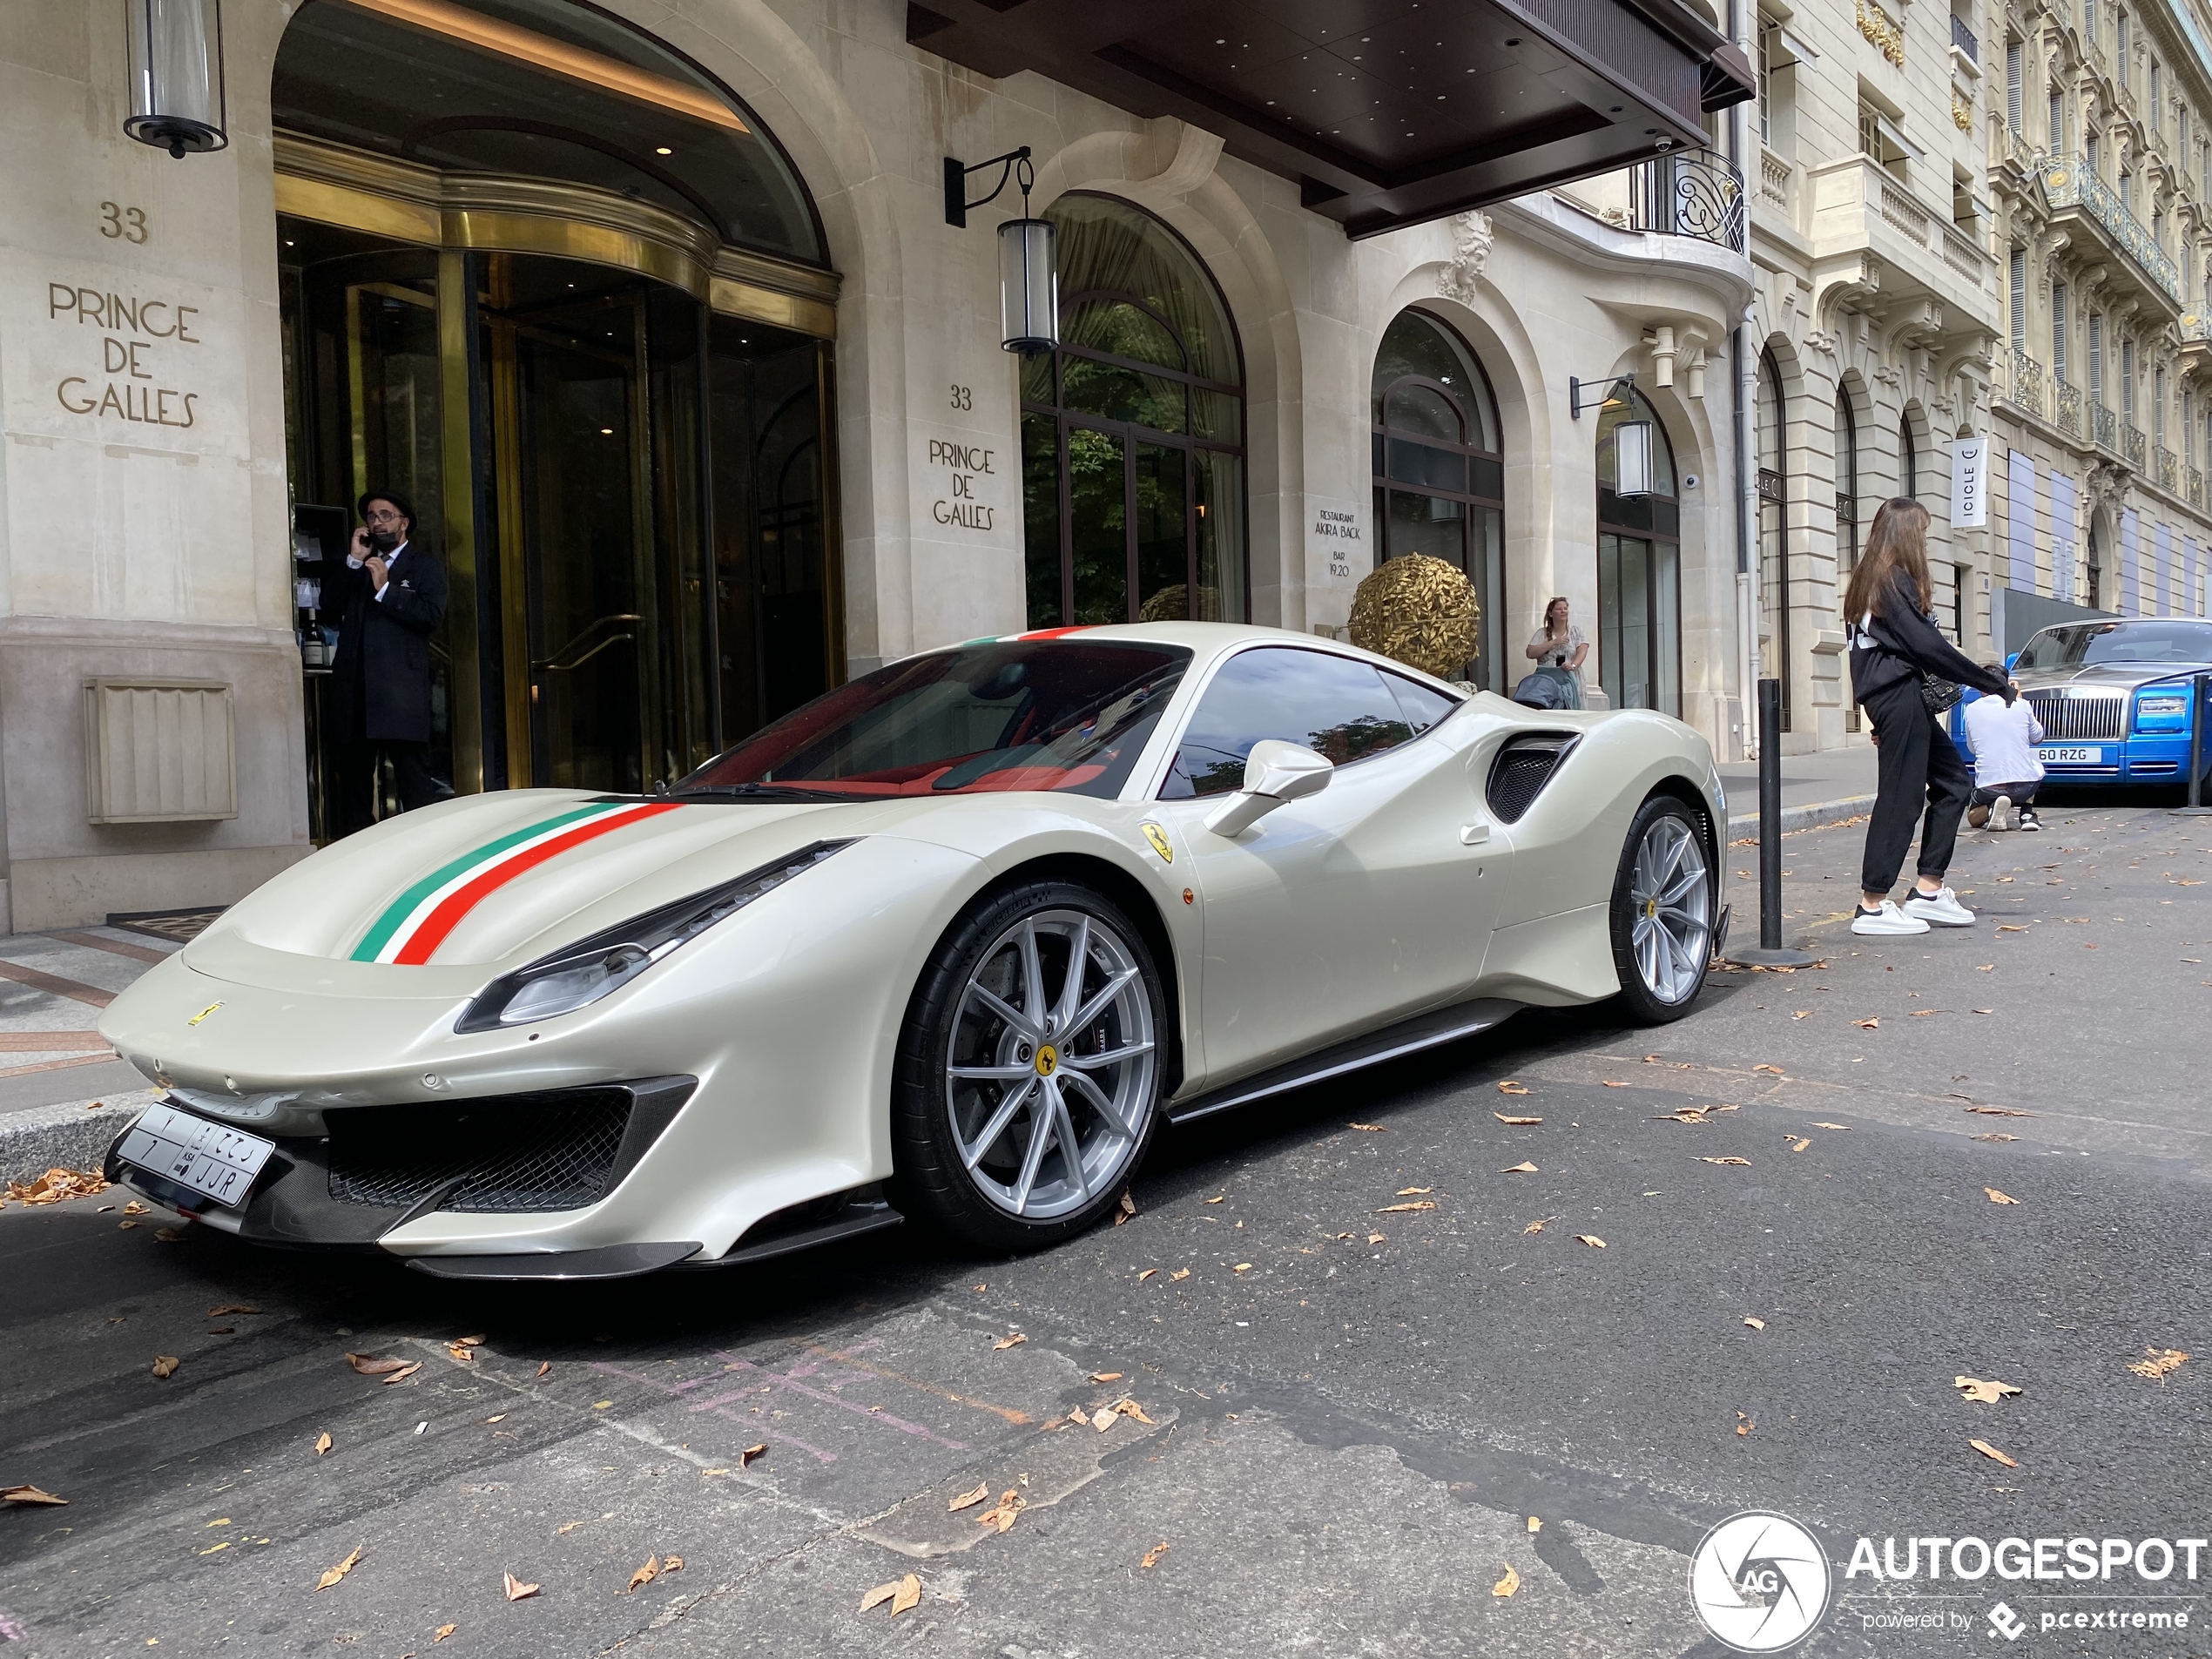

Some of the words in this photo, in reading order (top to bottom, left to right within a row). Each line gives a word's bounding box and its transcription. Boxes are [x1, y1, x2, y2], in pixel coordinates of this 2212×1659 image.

[100, 201, 149, 245] 33
[49, 282, 200, 343] PRINCE
[104, 336, 152, 380] DE
[57, 376, 199, 428] GALLES
[950, 384, 972, 411] 33
[929, 439, 995, 475] PRINCE
[953, 473, 974, 500] DE
[1963, 467, 1974, 516] ICICLE
[933, 500, 995, 531] GALLES
[1314, 522, 1339, 537] AKIRA
[1340, 525, 1361, 540] BACK
[1319, 509, 1355, 523] RESTAURANT
[1332, 550, 1345, 561] BAR
[2060, 749, 2087, 760] RZG
[984, 895, 1032, 936] MICHELIN
[181, 1150, 196, 1163] KSA
